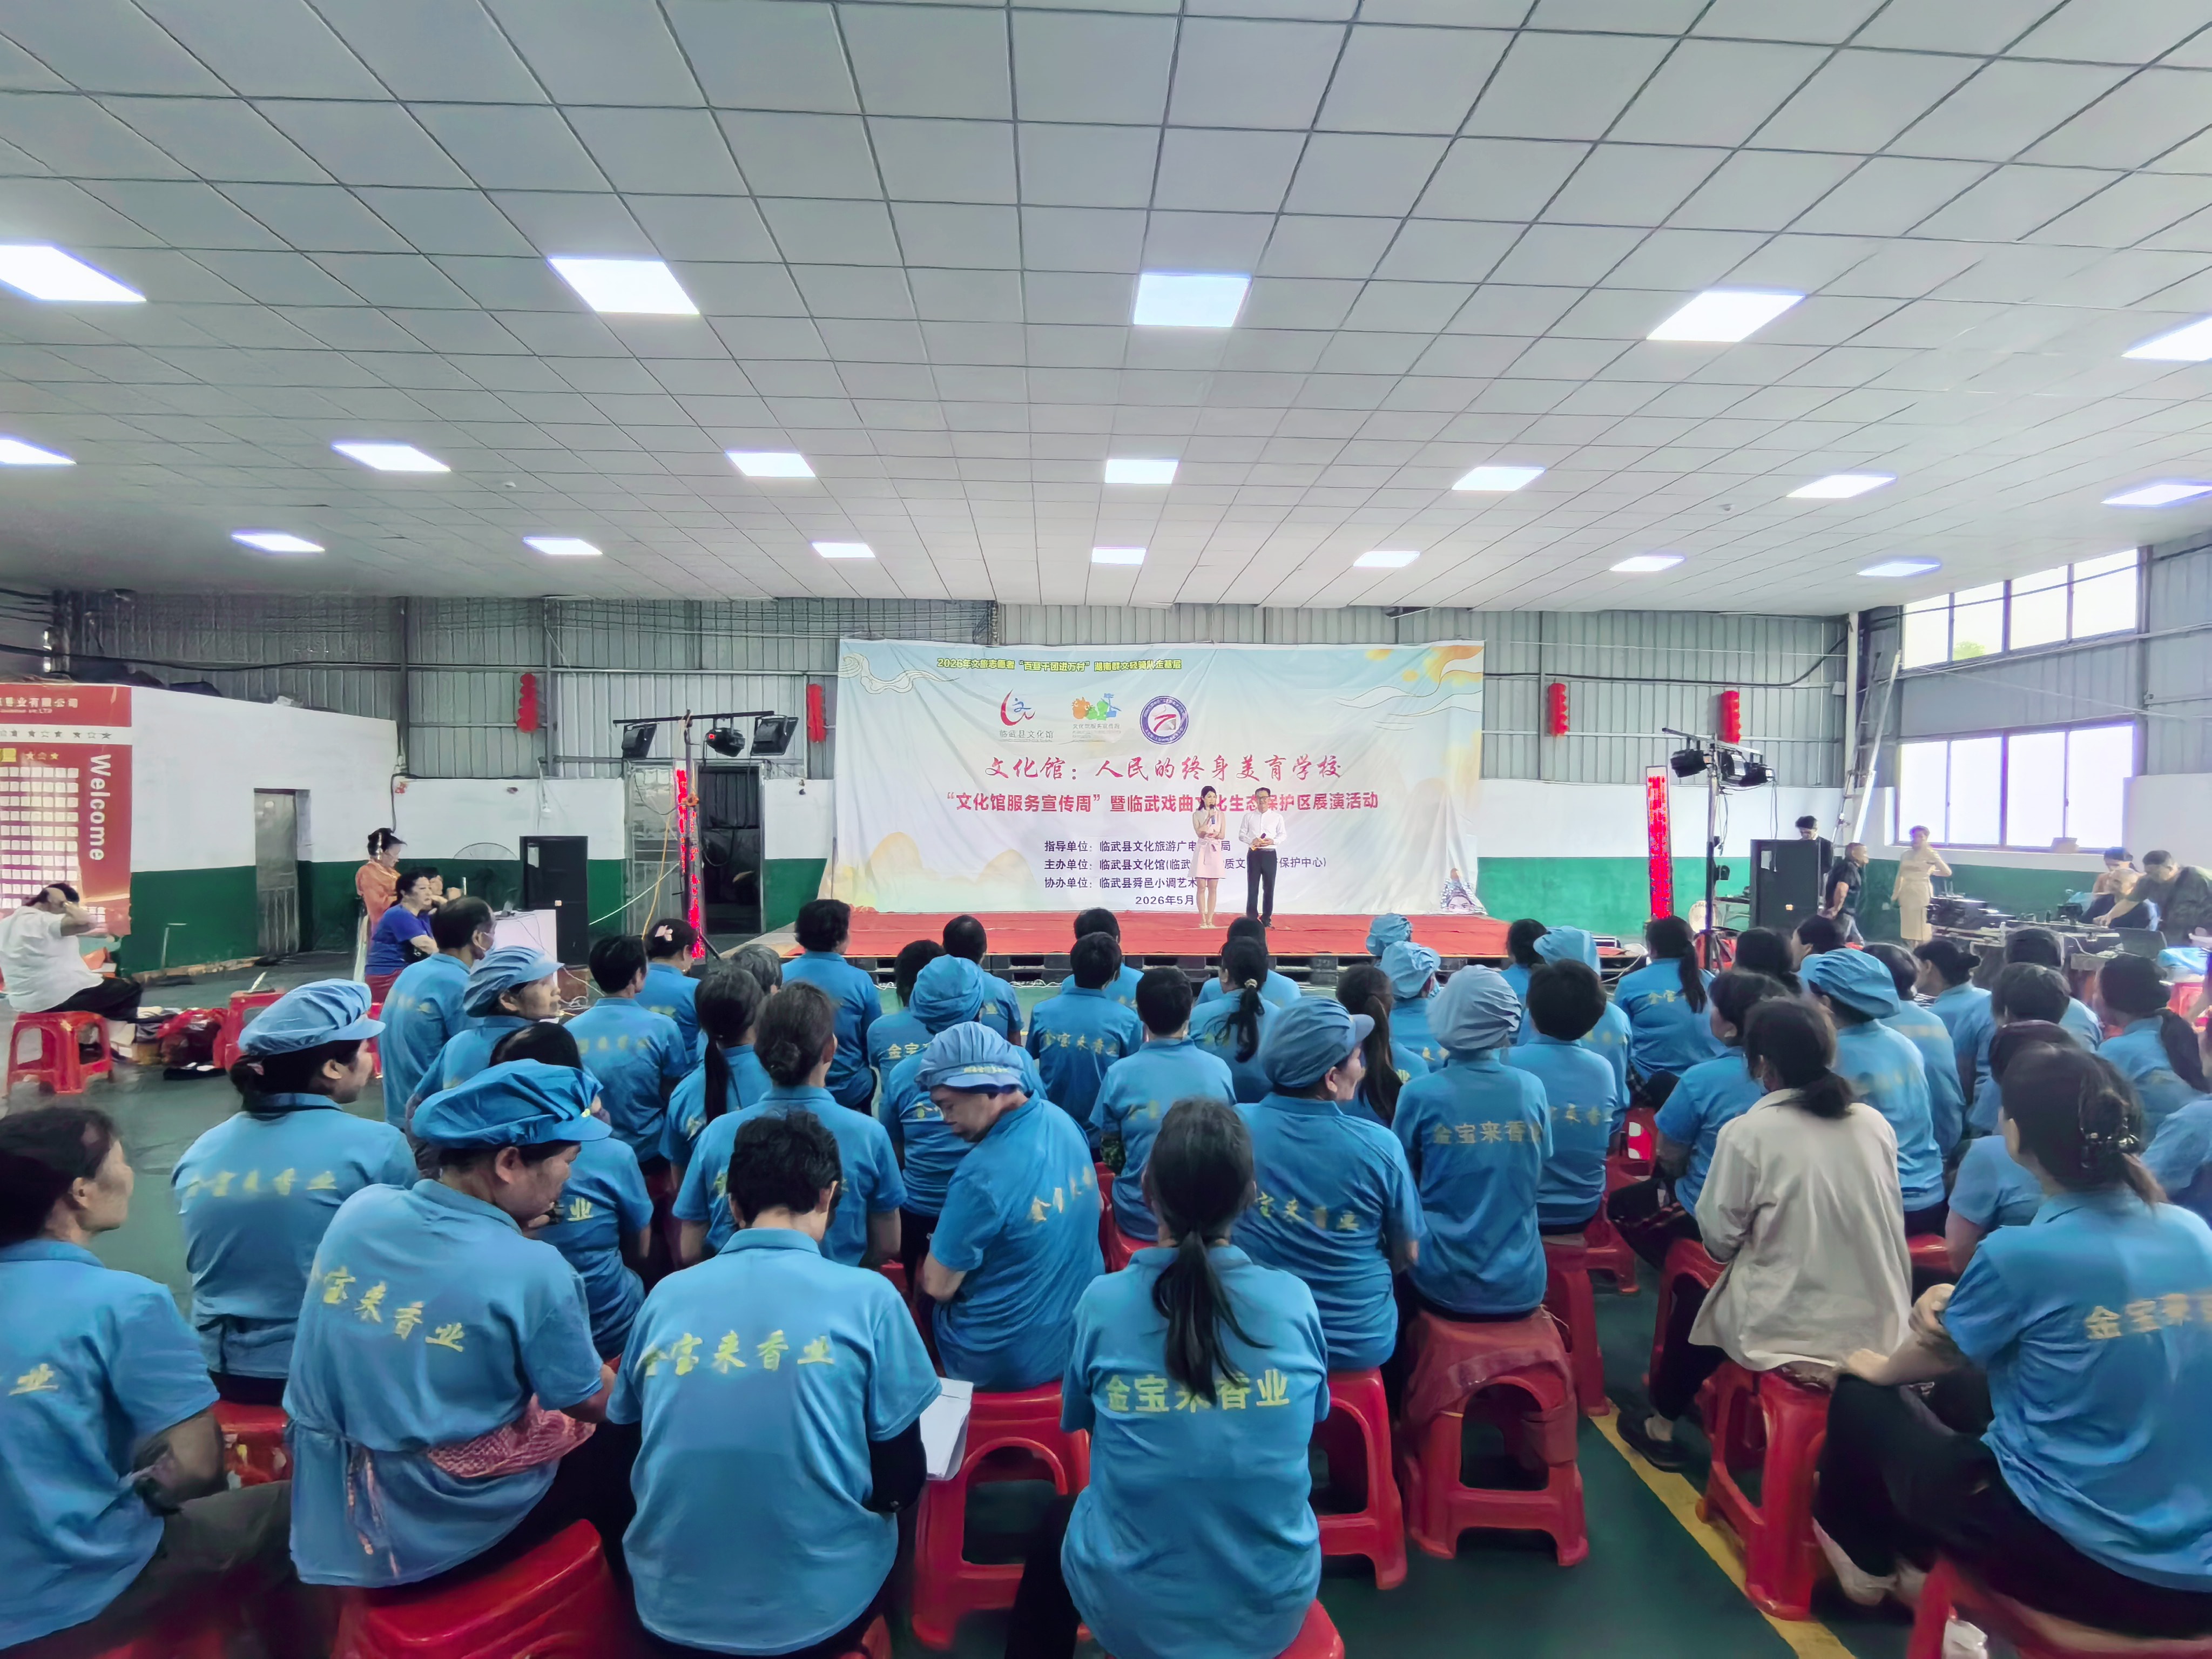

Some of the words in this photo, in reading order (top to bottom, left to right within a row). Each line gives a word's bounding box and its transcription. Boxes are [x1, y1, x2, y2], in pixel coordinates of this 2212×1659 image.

[90, 754, 111, 860] Welcome
[1044, 840, 1231, 852] 指导单位：临武县文化旅游广电局
[1044, 857, 1326, 871] 主办单位：临武县文化馆(临武质文保护中心)
[1044, 877, 1197, 889] 协办单位：临武县舜邑小调艺术
[1135, 895, 1194, 905] 2026年5月
